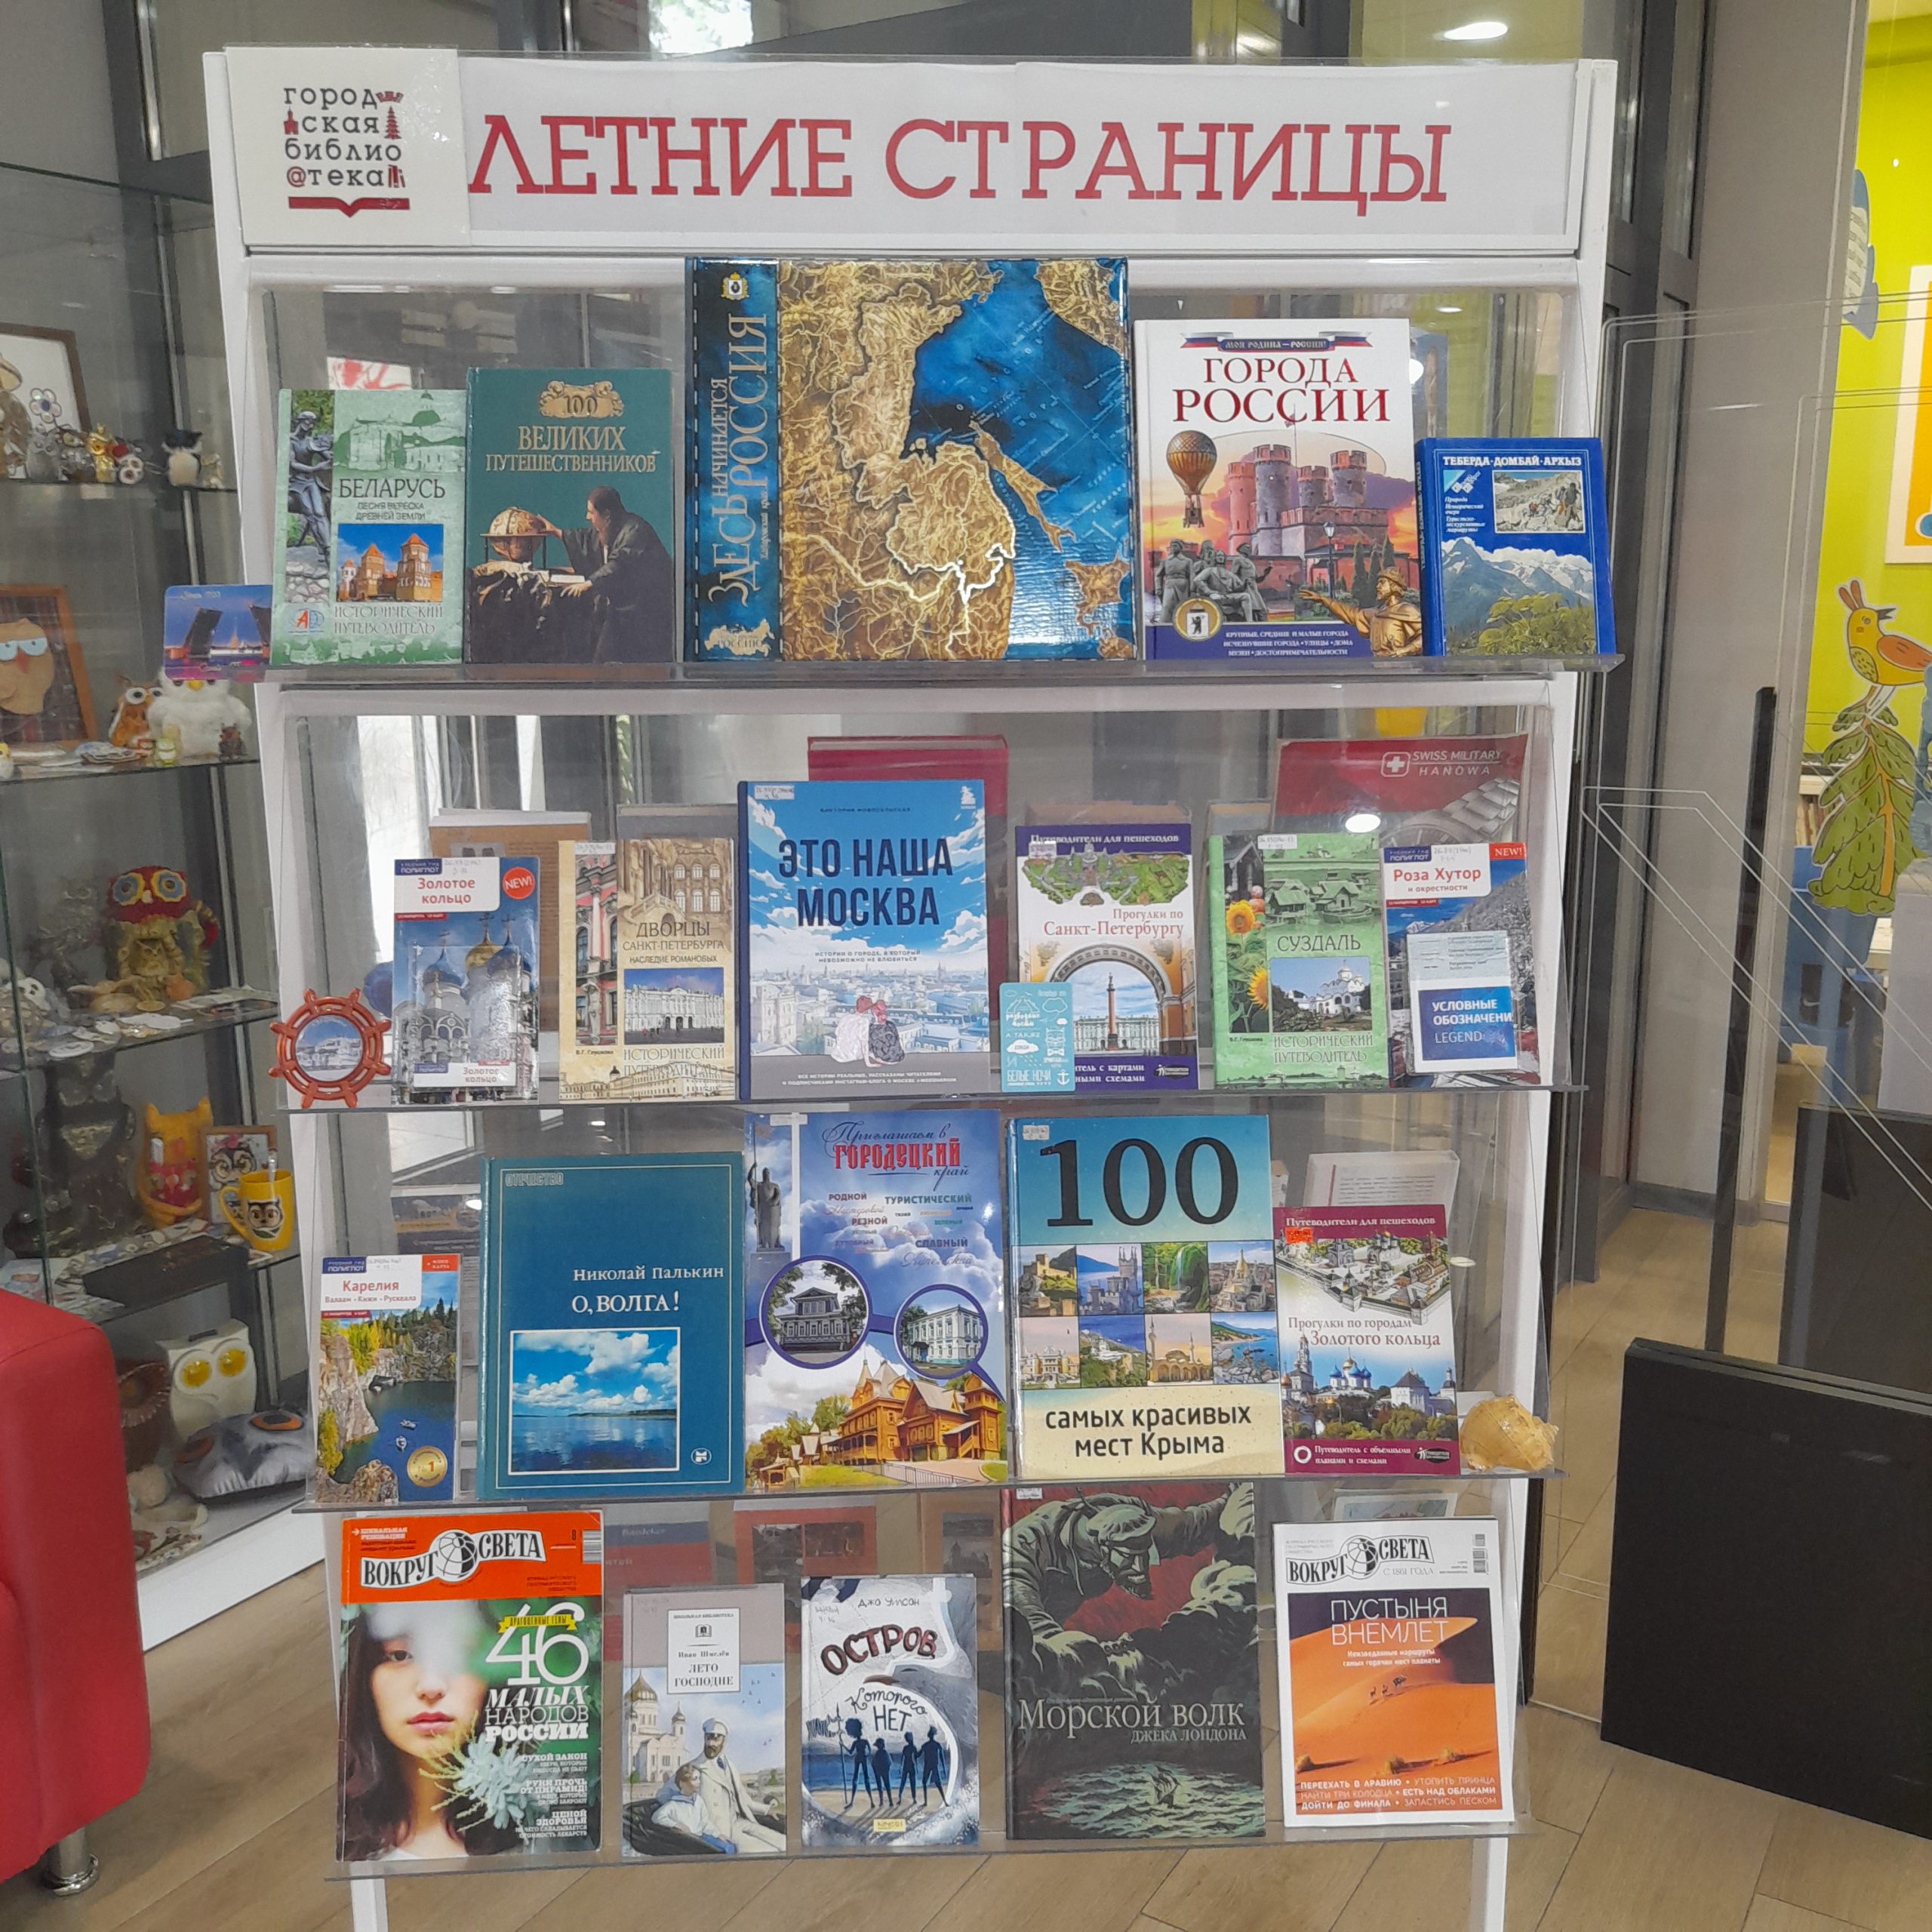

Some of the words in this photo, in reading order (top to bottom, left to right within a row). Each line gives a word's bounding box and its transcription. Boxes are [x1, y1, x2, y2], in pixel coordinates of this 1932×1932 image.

[284, 88, 378, 108] город
[303, 117, 379, 134] ская
[285, 140, 401, 161] библио
[469, 115, 853, 197] ЛЕТНИЕ
[886, 118, 1451, 217] СТРАНИЦЫ
[287, 167, 384, 187] @тека
[1204, 358, 1358, 389] ГОРОДА
[565, 395, 597, 414] 100
[728, 314, 768, 488] РОССИЯ
[1173, 389, 1391, 423] РОССИИ
[518, 426, 626, 451] ВЕЛИКИХ
[711, 378, 728, 497] НАЧИНАЕТСЯ
[486, 454, 656, 473] ПУТЕШЕСТВЕННИКОВ
[339, 478, 445, 499] БЕЛАРУСЬ
[709, 493, 760, 608] ЗДЕСЬ
[334, 604, 442, 619] ИСТОРИЧЕСКИЙ
[1412, 750, 1447, 761] SWISS
[1451, 750, 1503, 760] MILITARY
[1419, 765, 1491, 777] HANOWA
[1031, 835, 1101, 843] Путеводители
[779, 839, 841, 878] ЭТО
[853, 838, 953, 877] НАША
[1495, 848, 1522, 856] NEW!
[505, 875, 533, 890] NEW!
[1394, 869, 1429, 881] Роза
[1435, 868, 1481, 882] Хутор
[418, 878, 475, 889] Золотое
[423, 894, 471, 904] кольцо
[798, 887, 940, 928] МОСКВА
[1113, 909, 1167, 922] Прогулки
[1170, 910, 1183, 919] по
[636, 921, 710, 938] ДВОРЦЫ
[1044, 921, 1184, 940] Санкт-Петербургу
[623, 940, 724, 952] САНКТ-ПЕТЕРБУРГА
[1277, 935, 1361, 952] СУЗДАЛЬ
[629, 955, 669, 964] НАСЛЕДИЕ
[1432, 999, 1497, 1012] УСЛОВНЫЕ
[1274, 1032, 1373, 1048] ИСТОРИЧЕСКИЙ
[1435, 1030, 1482, 1044] LEGEND
[623, 1044, 724, 1060] ИСТОРИЧЕСКИЙ
[1274, 1050, 1367, 1063] ПУТЕВОДИТЕЛЬ
[1108, 1063, 1145, 1072] картами
[1105, 1074, 1145, 1083] схемами
[835, 1138, 960, 1171] ГОРОДЕЦКИЙ
[933, 1166, 970, 1192] край
[1040, 1137, 1239, 1227] 100
[885, 1194, 972, 1204] ТУРИСТИЧЕСКИЙ
[852, 1216, 888, 1225] РЕЗНОЙ
[1286, 1217, 1358, 1228] Путеводители
[1359, 1218, 1377, 1226] для
[1379, 1217, 1435, 1226] пешеходов
[915, 1238, 968, 1248] СЛАВНЫЙ
[574, 1265, 646, 1281] Николай
[652, 1266, 724, 1280] Палькин
[343, 1281, 398, 1294] Карелия
[1288, 1317, 1344, 1331] Прогулки
[1347, 1318, 1361, 1328] по
[1364, 1319, 1411, 1331] городам
[1310, 1330, 1380, 1347] Золотого
[1385, 1334, 1441, 1348] кольца
[1045, 1408, 1124, 1429] самых
[1132, 1405, 1251, 1432] красивых
[1075, 1437, 1132, 1458] мест
[1141, 1432, 1225, 1463] Крыма
[1315, 1446, 1361, 1455] Путеводитель
[363, 1551, 439, 1586] ВОКРУГ
[478, 1531, 543, 1558] СВЕТА
[1289, 1554, 1348, 1583] ВОКРУГ
[1379, 1538, 1430, 1561] СВЕТА
[1331, 1597, 1447, 1622] ПУСТЫНЯ
[1331, 1621, 1449, 1645] ВНЕМЛЕТ
[486, 1601, 589, 1685] 46
[820, 1624, 938, 1675] ОСТРОВ
[1347, 1650, 1397, 1658] Неизведанные
[688, 1663, 718, 1673] ЛЕТО
[1366, 1659, 1393, 1667] горячих
[675, 1676, 734, 1687] ГОСПОДНЕ
[485, 1685, 589, 1709] МАЛЫХ
[845, 1687, 928, 1715] Которого
[485, 1705, 589, 1726] НАРОДОВ
[873, 1705, 912, 1732] НЕТ
[1018, 1696, 1161, 1738] Морской
[485, 1722, 589, 1742] РОССИИ
[1131, 1730, 1178, 1744] ДЖЕКА
[1180, 1729, 1247, 1743] ЛОНДОНА
[1300, 1781, 1350, 1790] ПЕРЕЕХАТЬ
[1364, 1779, 1401, 1787] АРАВИЮ
[1414, 1778, 1454, 1786] УТОПИТЬ
[1459, 1777, 1496, 1786] ПРИНЦА
[1403, 1788, 1424, 1797] ЕСТЬ
[1426, 1787, 1444, 1796] НАД
[1301, 1800, 1333, 1810] ДОЙТИ
[1337, 1801, 1349, 1810] ДО
[1354, 1800, 1391, 1808] ФИНАЛА
[1404, 1798, 1455, 1807] ЗАПАСТИСЬ
[1460, 1796, 1497, 1805] ПЕСКОМ
[536, 1817, 586, 1826] ЗДОРОВЬЯ
[552, 1809, 587, 1818] ЦЕНОЙ
